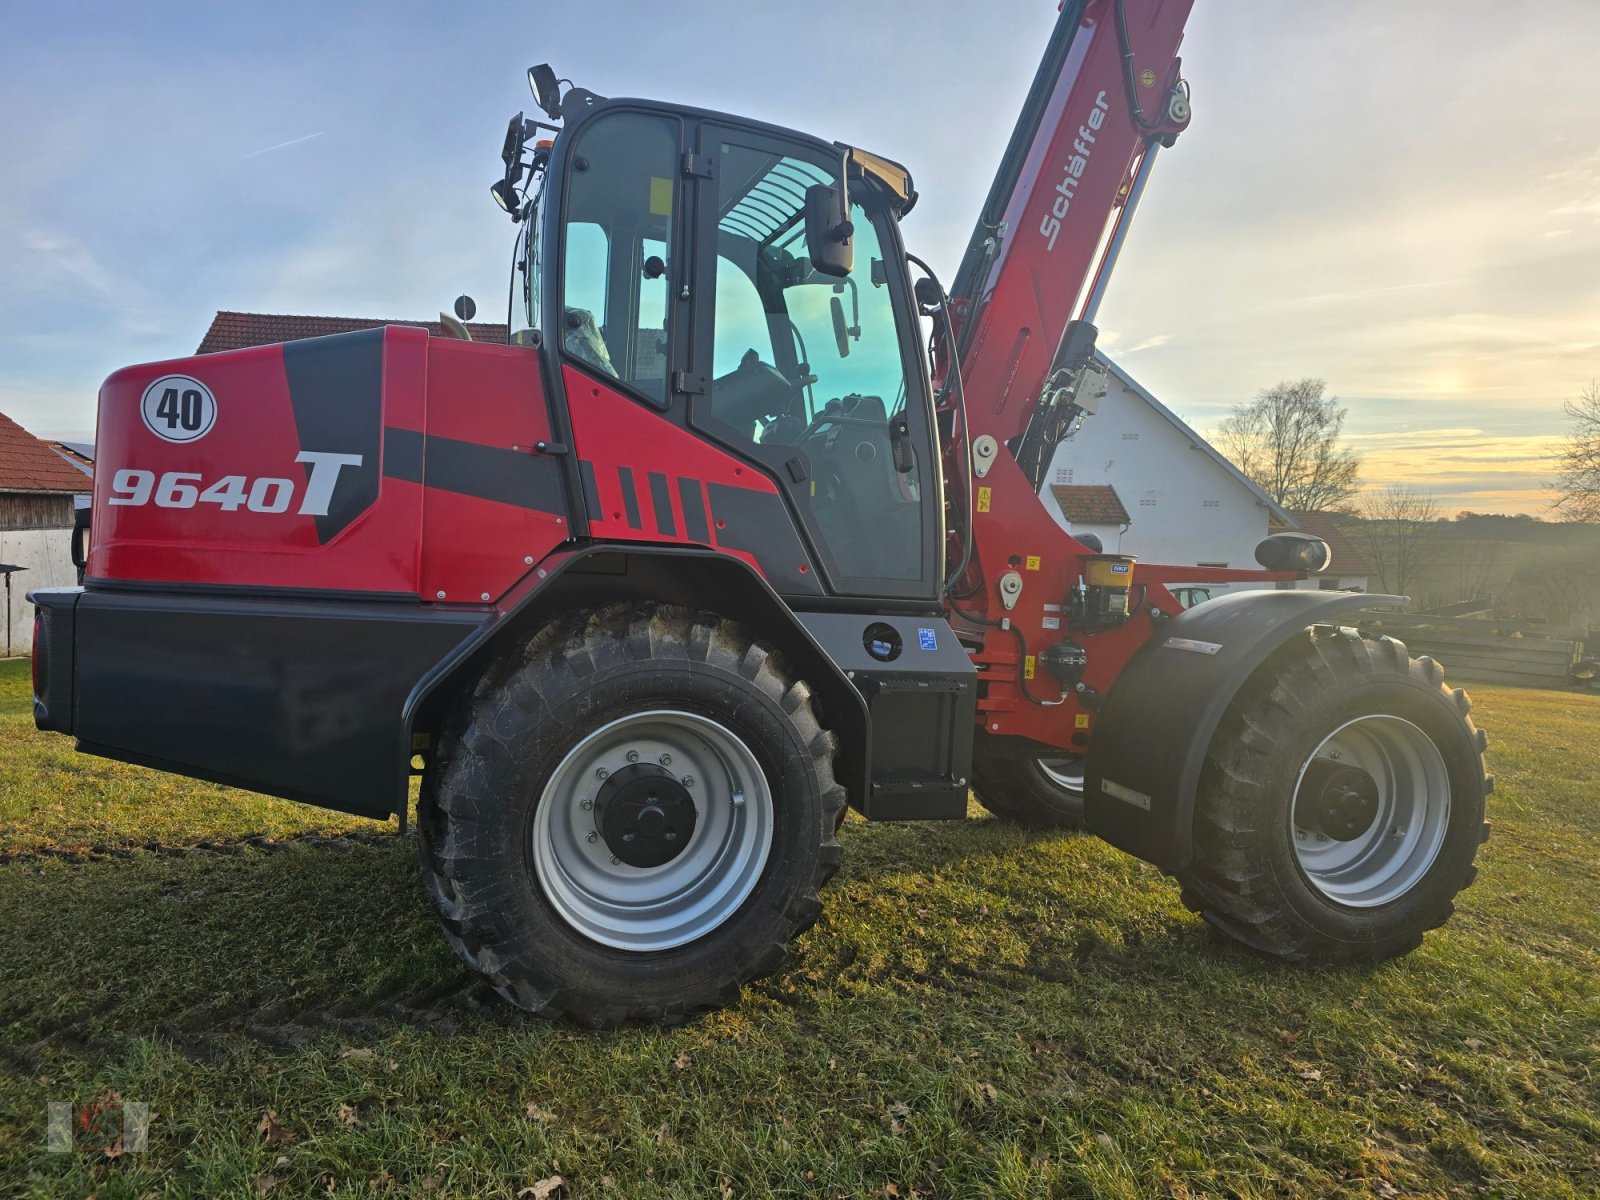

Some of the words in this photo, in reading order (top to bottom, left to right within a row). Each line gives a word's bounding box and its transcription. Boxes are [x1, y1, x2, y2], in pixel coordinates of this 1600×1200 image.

[1039, 89, 1109, 251] Schäffer
[156, 388, 203, 431] 40
[108, 450, 363, 516] 9640T
